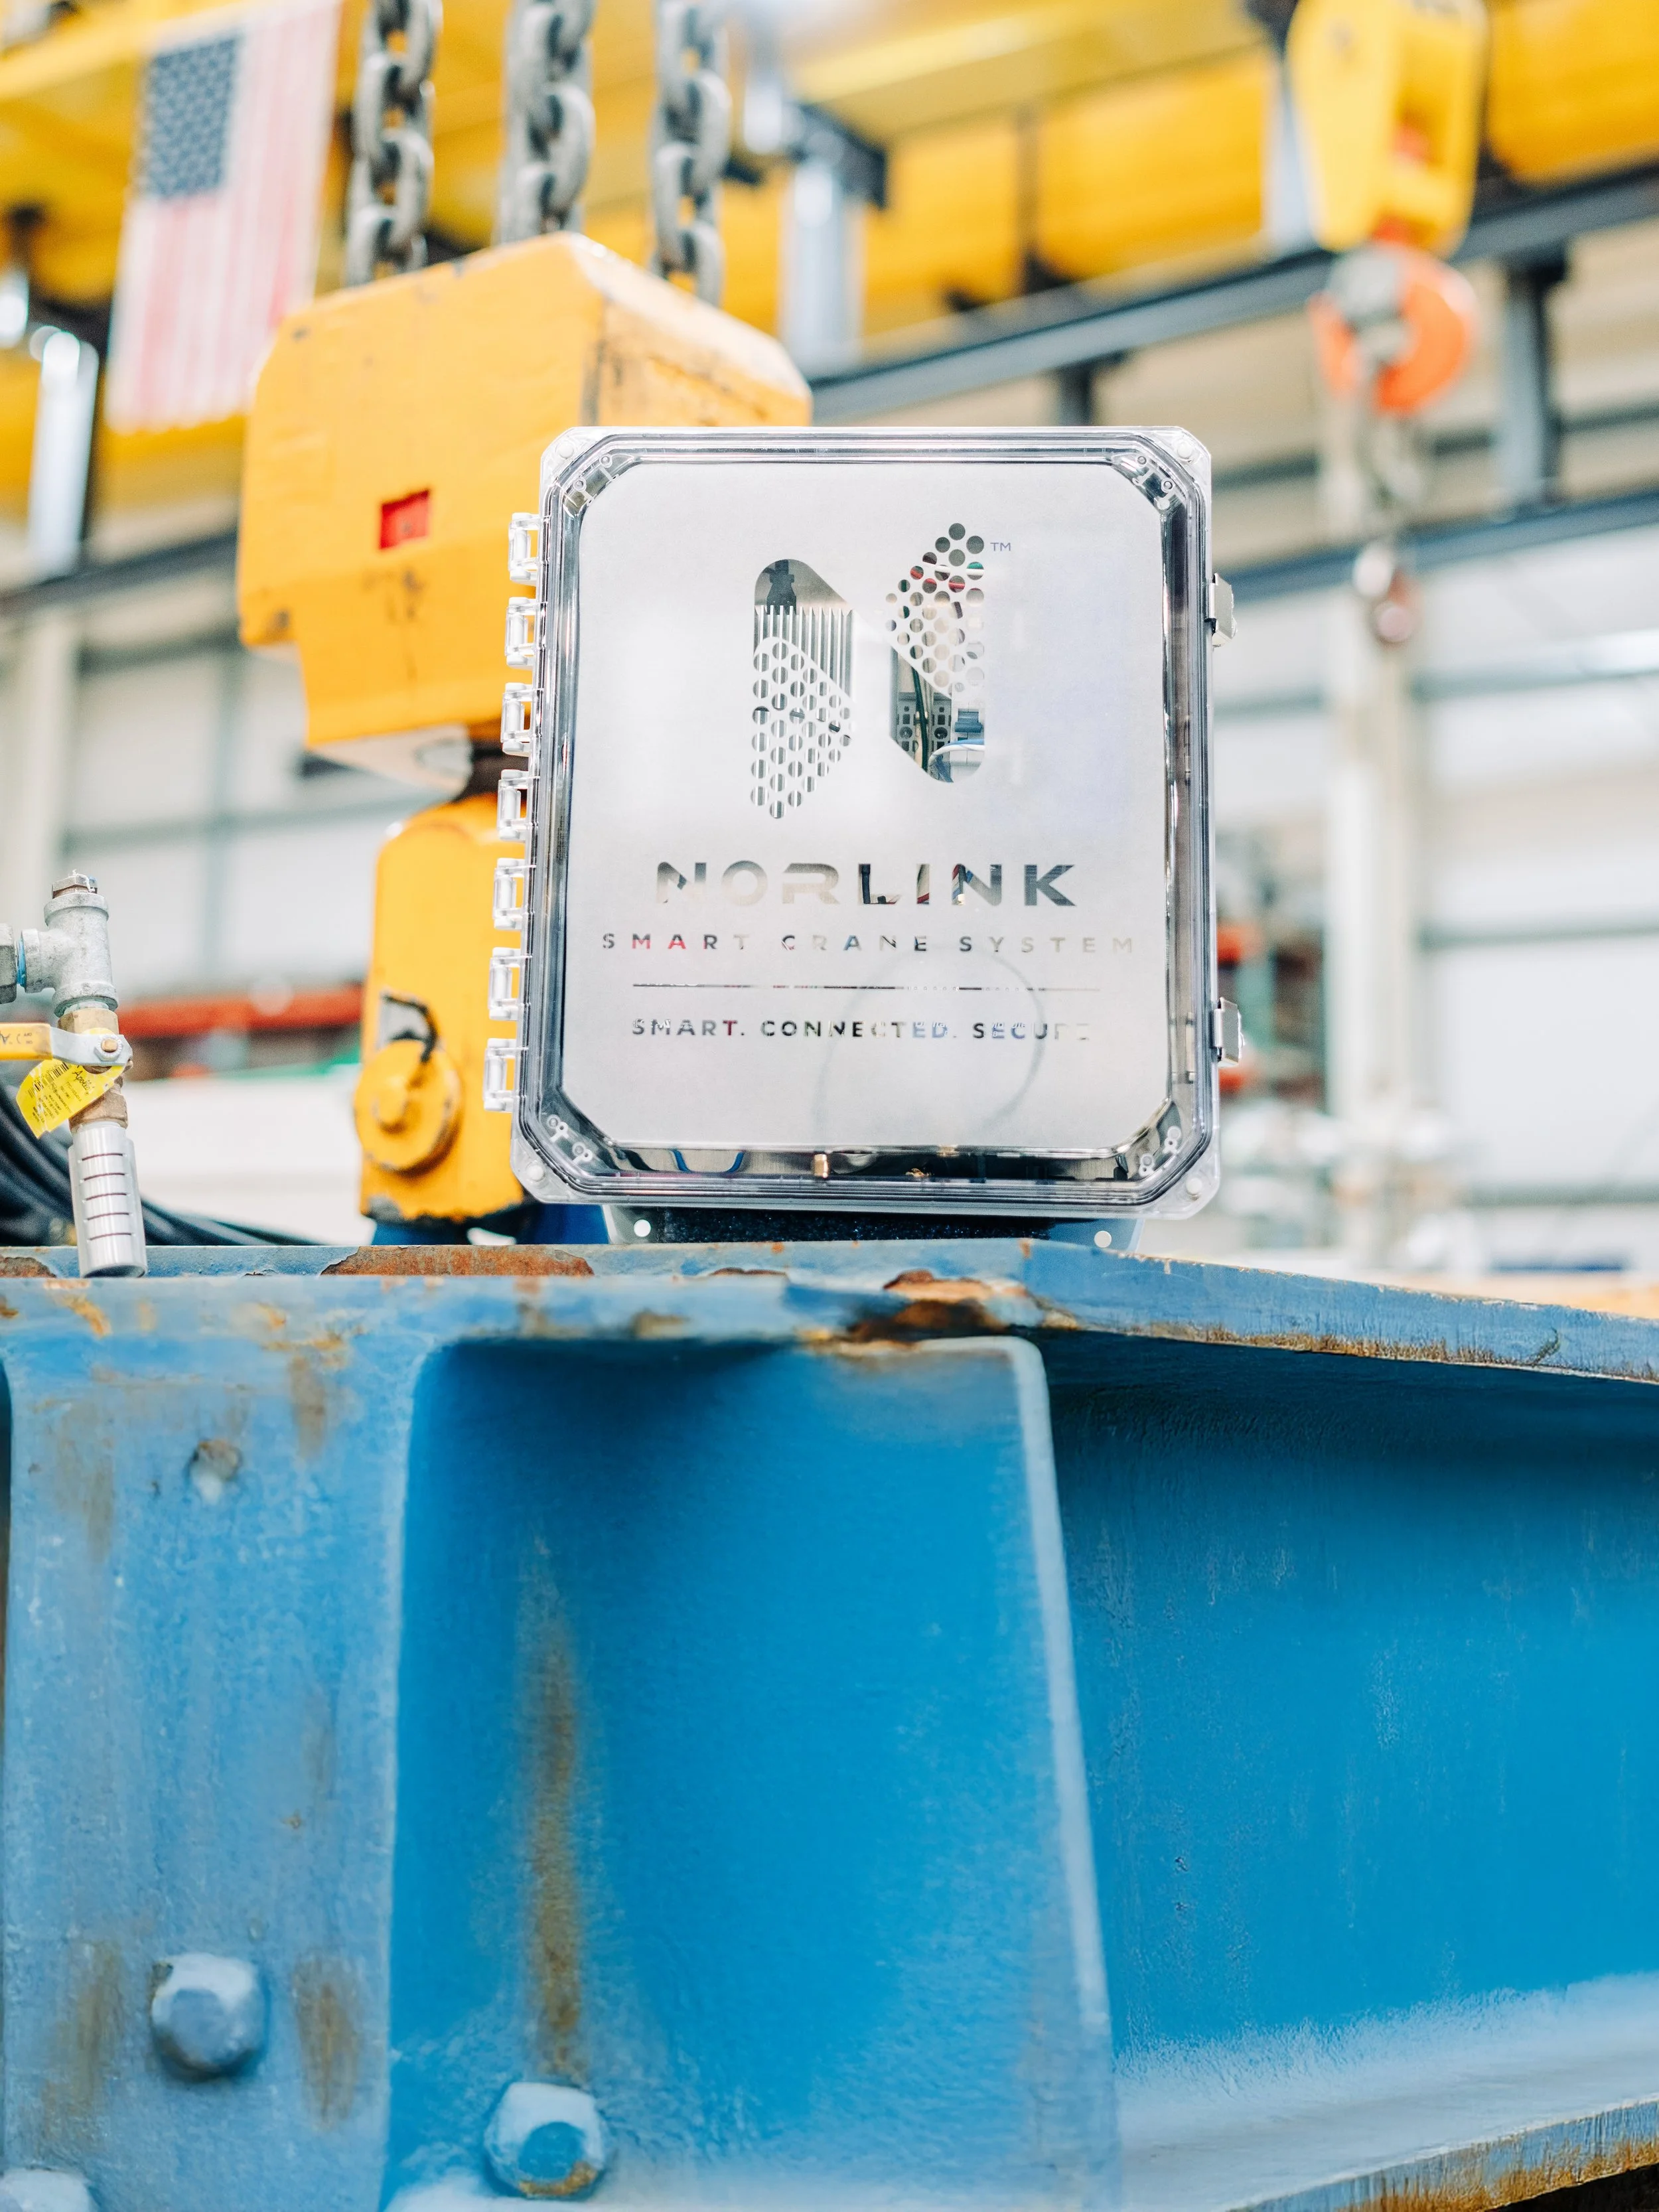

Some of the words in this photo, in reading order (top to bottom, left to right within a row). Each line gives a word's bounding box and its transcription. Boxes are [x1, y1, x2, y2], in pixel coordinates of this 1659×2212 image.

[990, 542, 1012, 552] TM
[656, 860, 1078, 907] NORLINK
[602, 932, 751, 950] SMART
[780, 933, 928, 953] CRANE
[958, 936, 1133, 954] SYSTEM
[632, 1019, 746, 1037] SMART.
[760, 1019, 958, 1039] CONNECTED.
